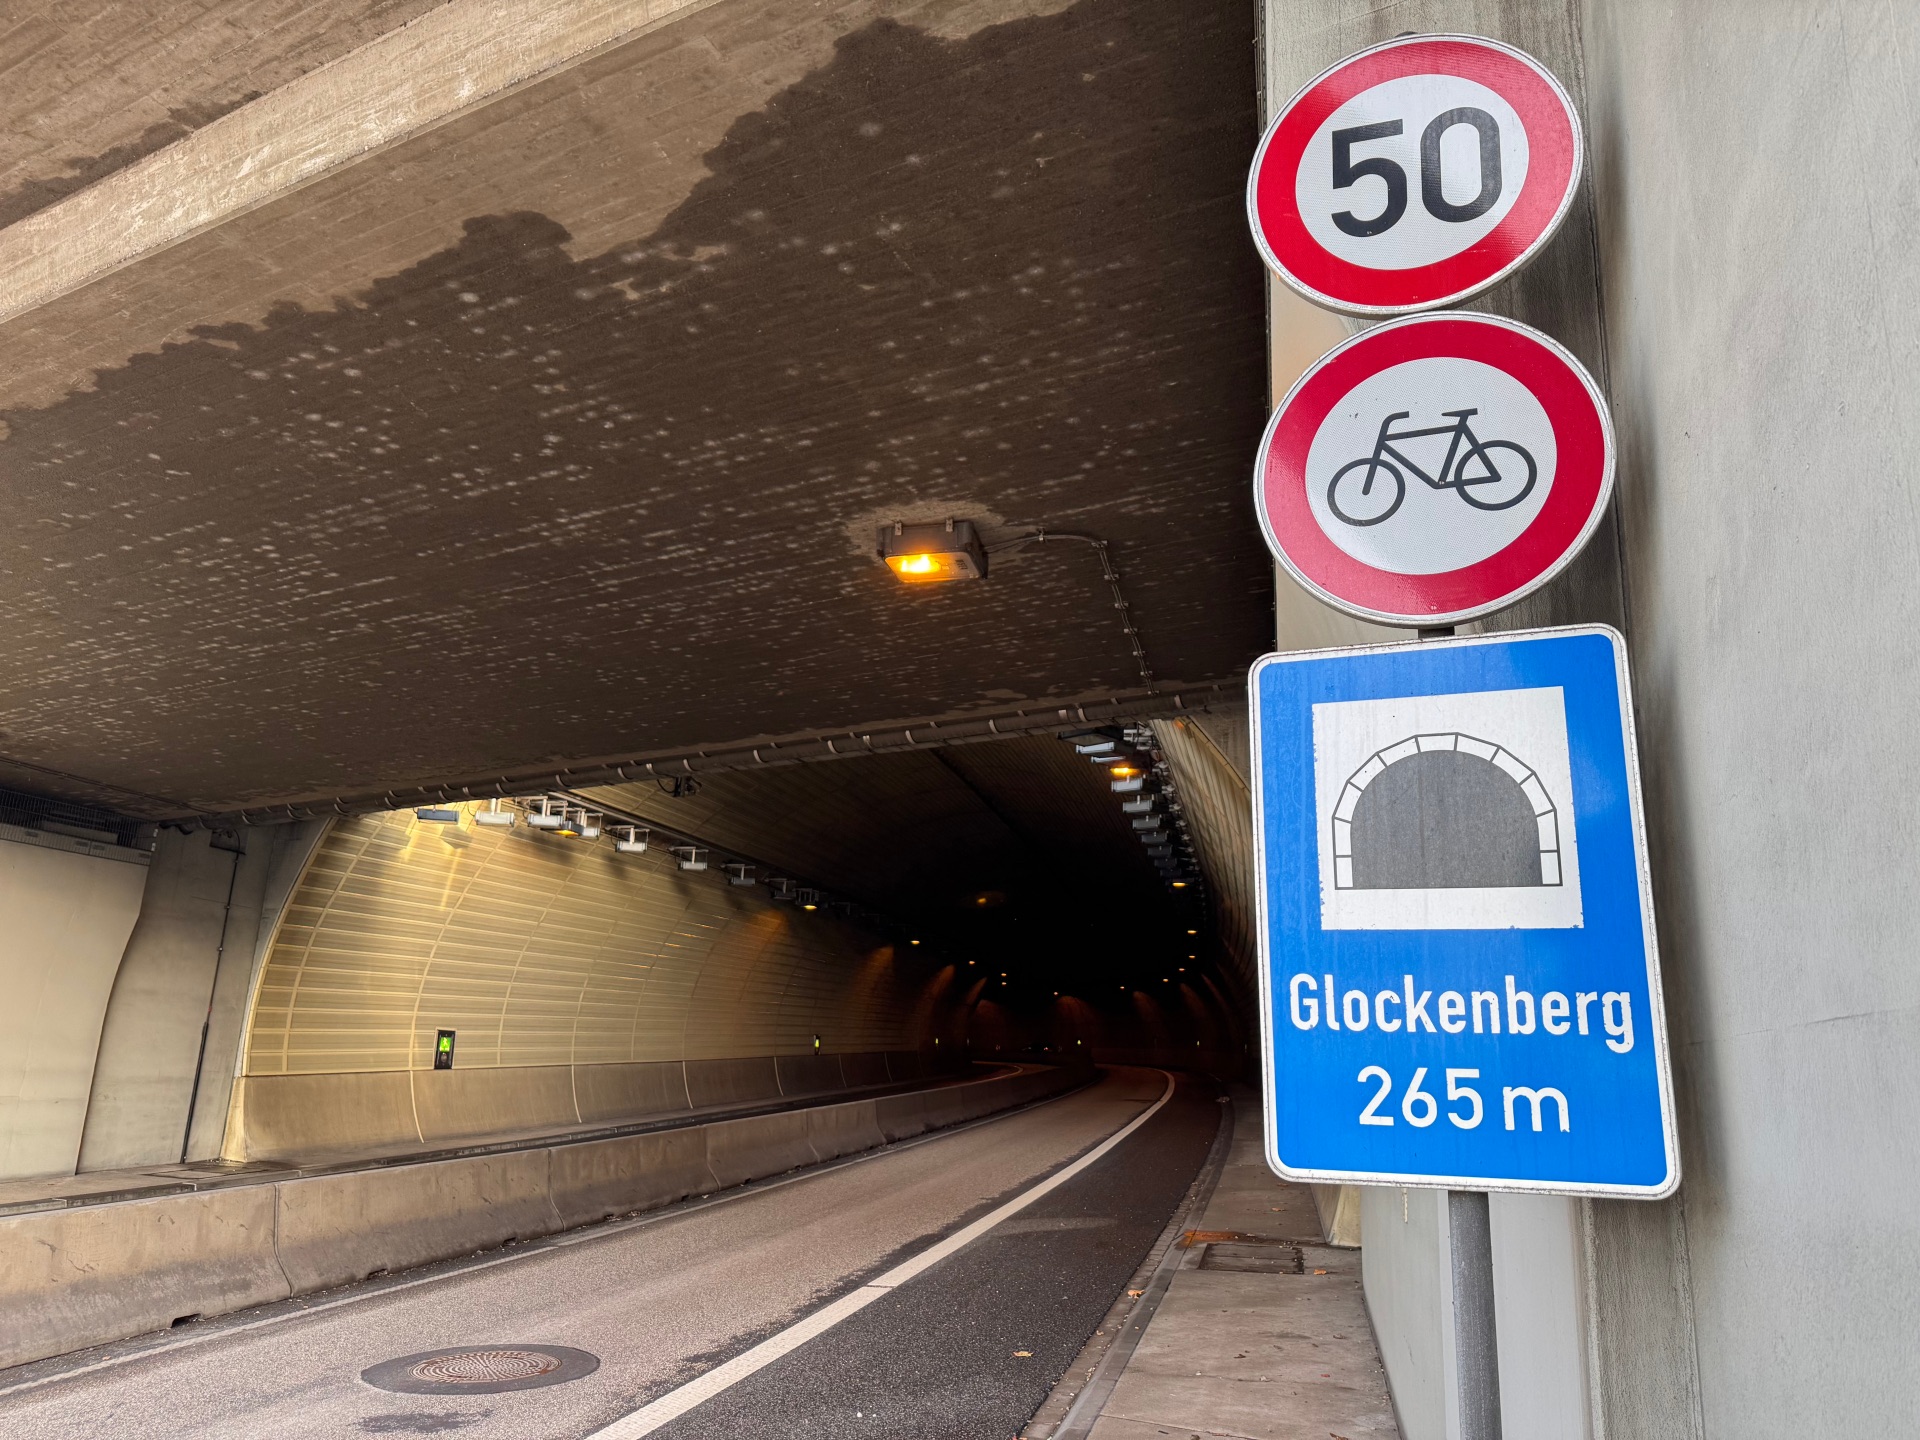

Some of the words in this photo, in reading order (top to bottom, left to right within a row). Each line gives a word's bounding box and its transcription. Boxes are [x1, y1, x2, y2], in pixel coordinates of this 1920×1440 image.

[1331, 106, 1503, 237] 50
[1289, 973, 1635, 1054] Glockenberg
[1357, 1065, 1484, 1130] 265
[1502, 1086, 1570, 1133] m
